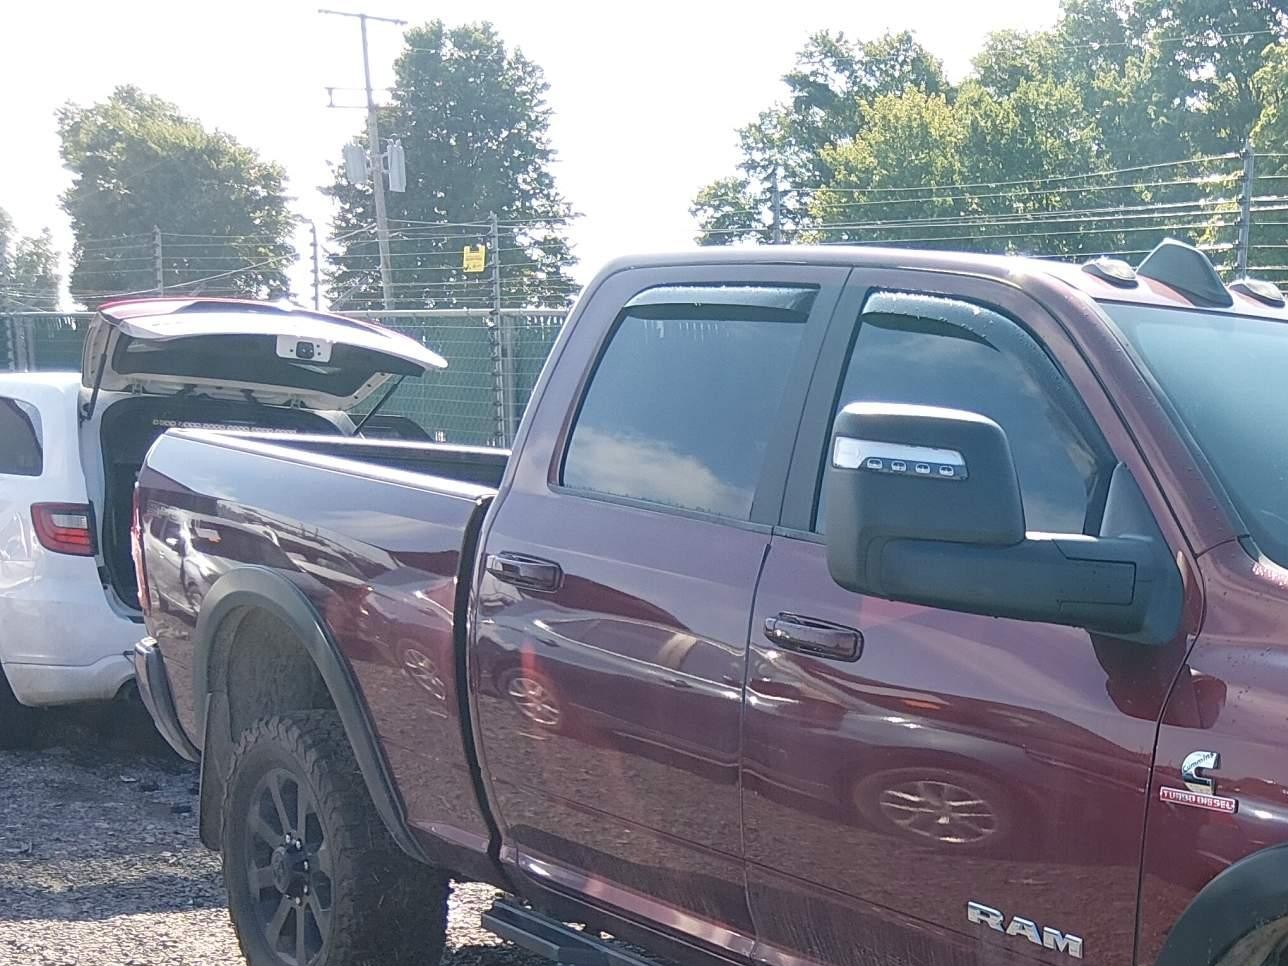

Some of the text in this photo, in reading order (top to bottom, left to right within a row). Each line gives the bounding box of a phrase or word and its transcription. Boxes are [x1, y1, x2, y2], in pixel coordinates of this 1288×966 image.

[1162, 790, 1235, 810] TURBO DIESEL
[967, 901, 1084, 959] RAM
